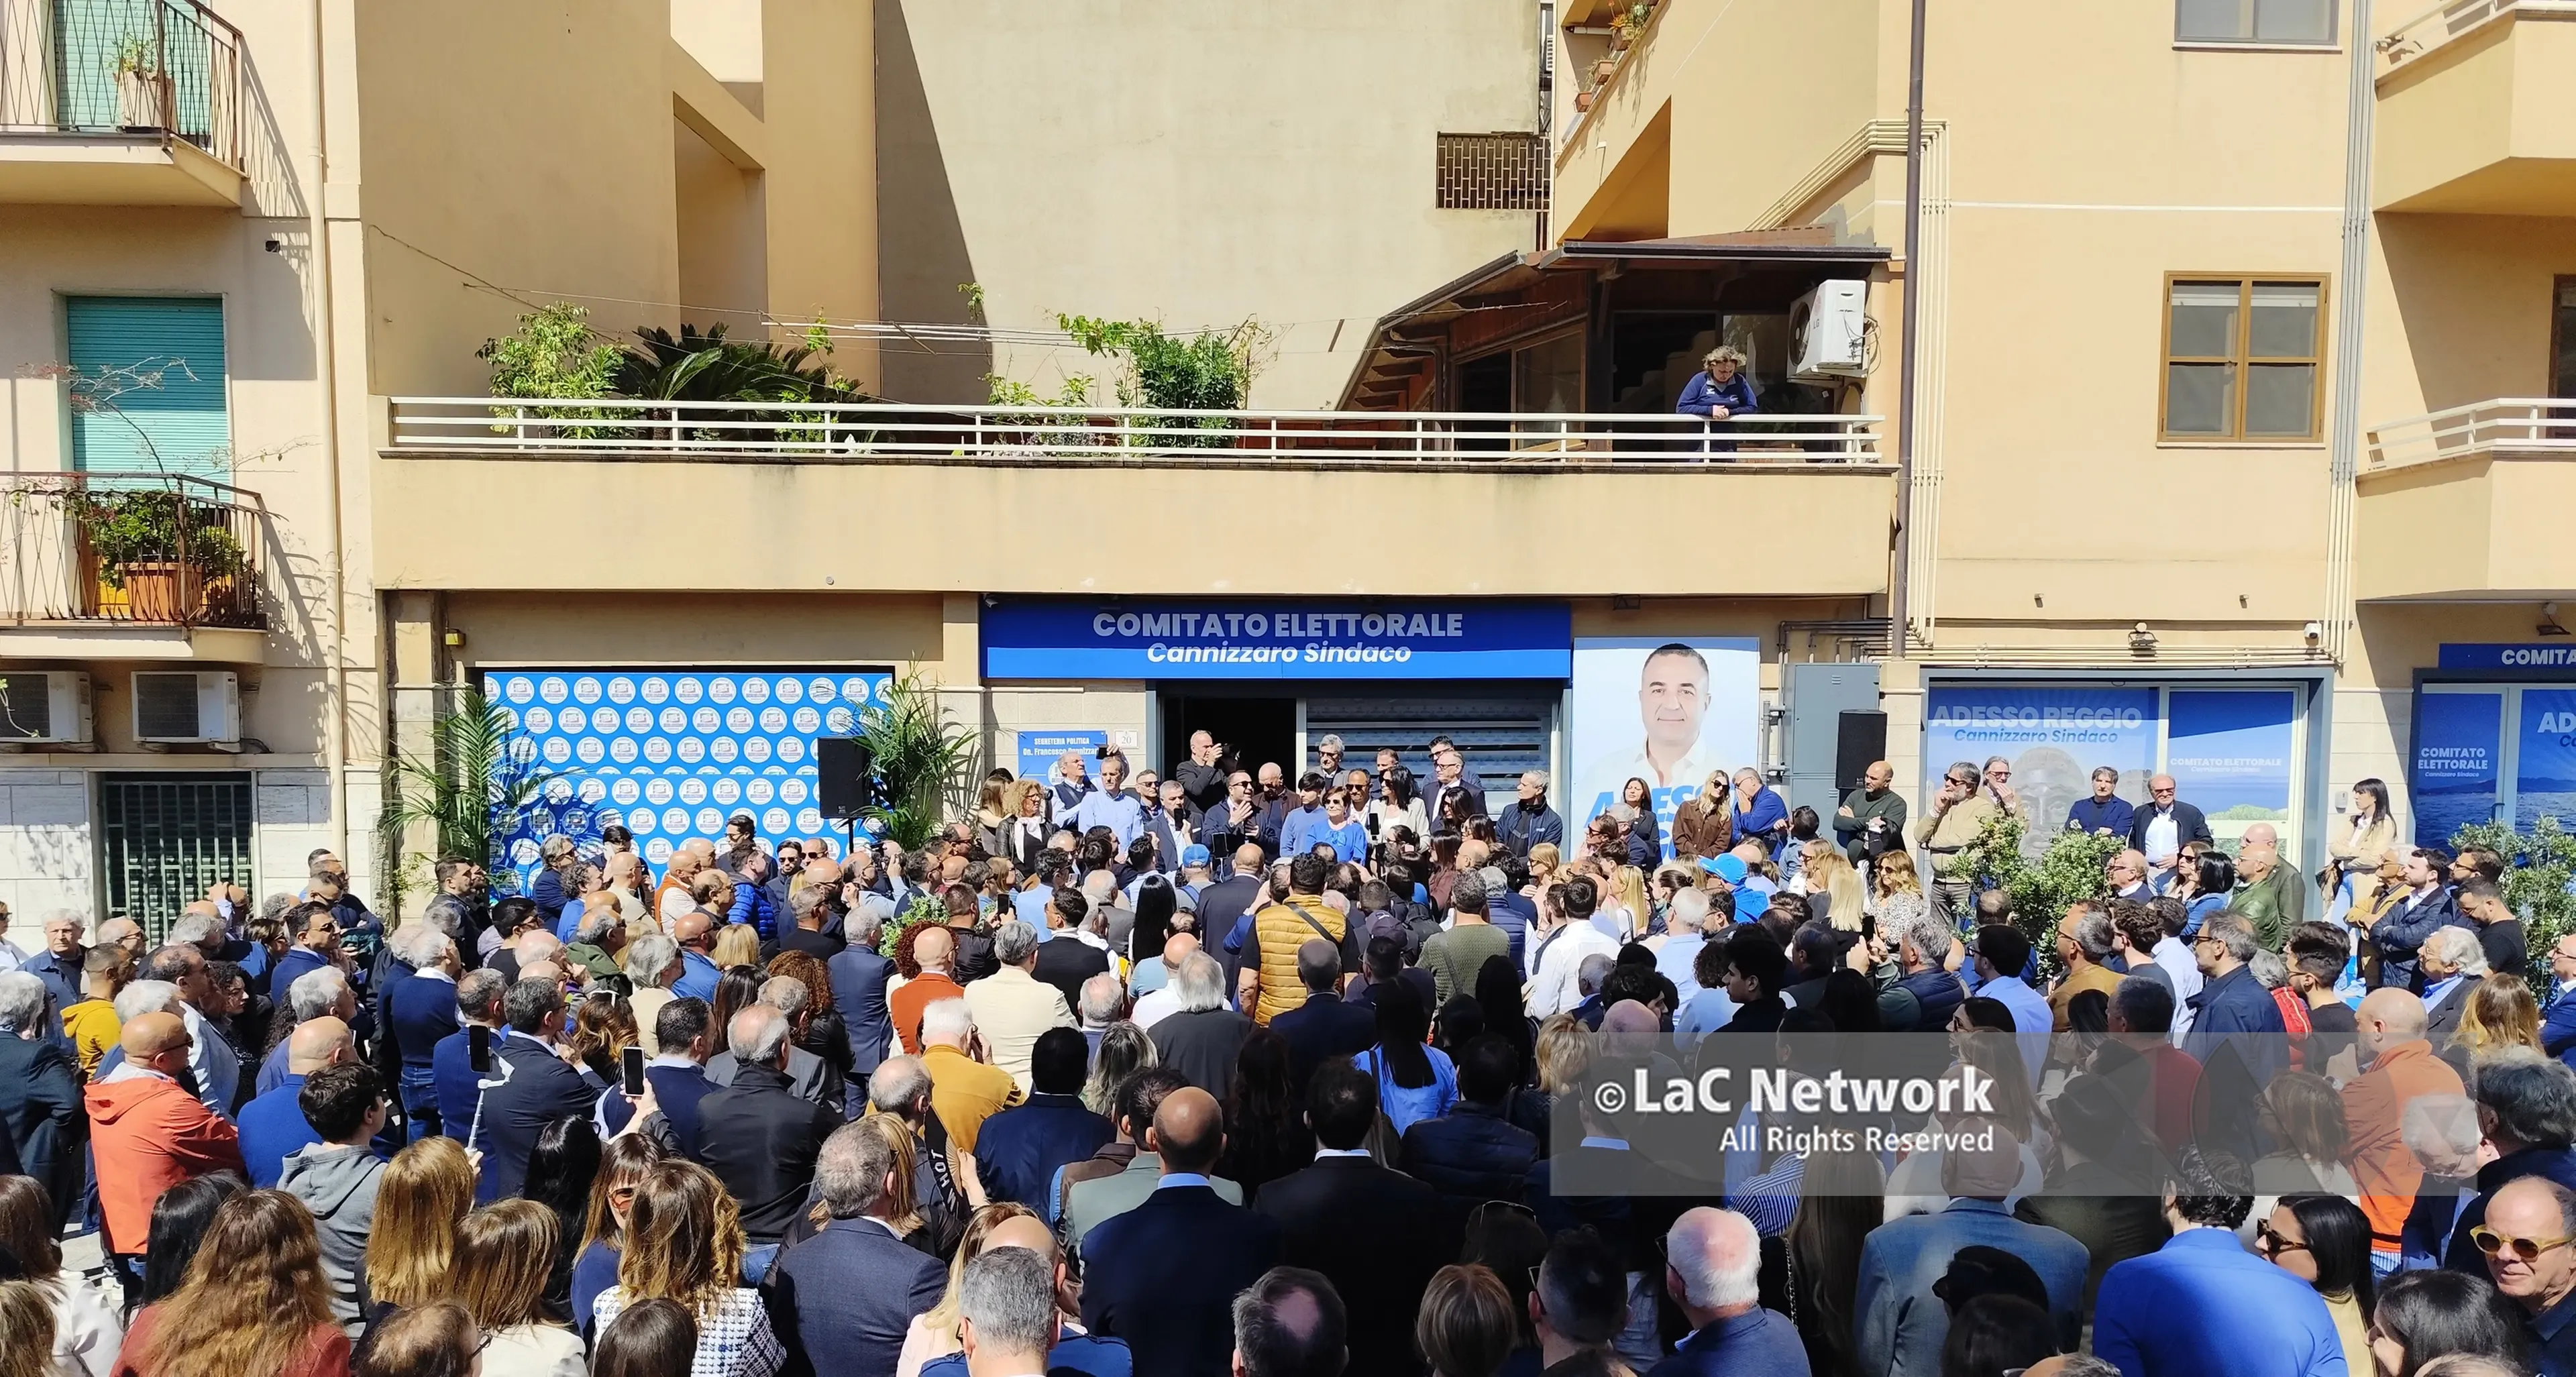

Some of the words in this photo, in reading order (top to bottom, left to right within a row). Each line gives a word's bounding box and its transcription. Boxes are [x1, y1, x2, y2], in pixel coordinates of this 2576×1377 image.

[1093, 612, 1269, 637] COMITATO
[1275, 613, 1463, 637] ELETTORALE
[1147, 641, 1298, 663] Cannizzaro
[1303, 641, 1411, 663] Sindaco
[1931, 705, 2039, 728] ADESSO
[2043, 707, 2143, 729] REGGIO
[1122, 736, 1132, 745] 20
[1954, 728, 2047, 742] Cannizzaro
[2051, 728, 2118, 743] Sindaco
[2420, 747, 2485, 758] COMITATO
[2170, 758, 2222, 766] COMITATO
[2224, 758, 2282, 767] ELETTORALE
[2418, 759, 2488, 769] ELETTORALE
